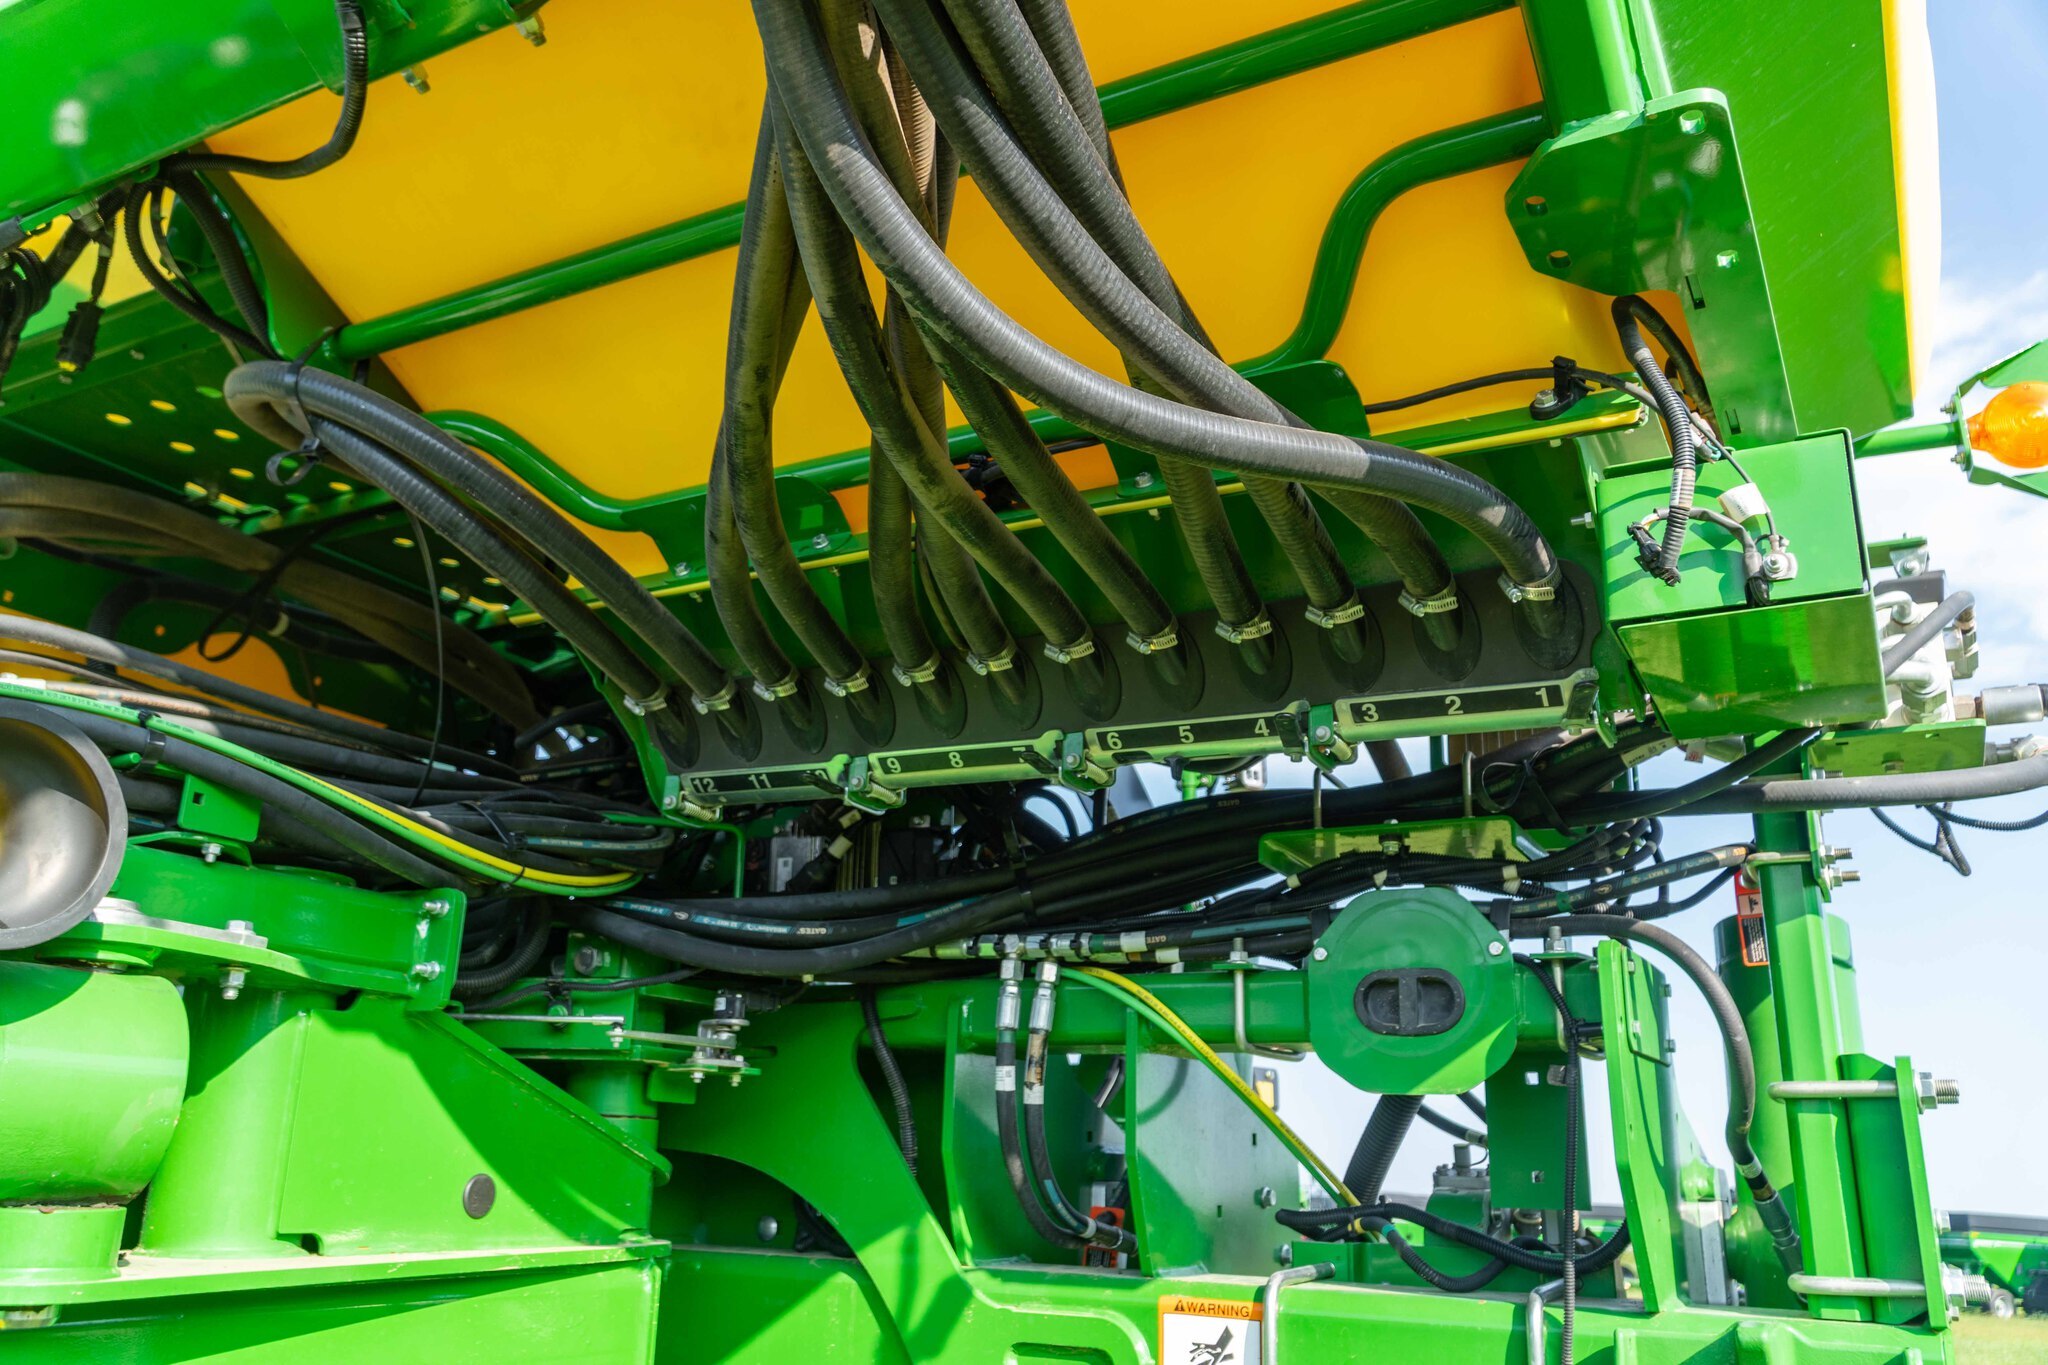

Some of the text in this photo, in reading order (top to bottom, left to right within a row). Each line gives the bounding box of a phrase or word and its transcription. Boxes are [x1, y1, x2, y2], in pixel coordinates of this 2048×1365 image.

[1361, 687, 1549, 723] 3 2 1
[1106, 718, 1270, 750] 6 5 4
[886, 757, 901, 774] 9
[948, 751, 964, 769] 8
[693, 773, 772, 793] 12 11
[1146, 935, 1167, 944] GATE
[1186, 1301, 1249, 1318] WARNING
